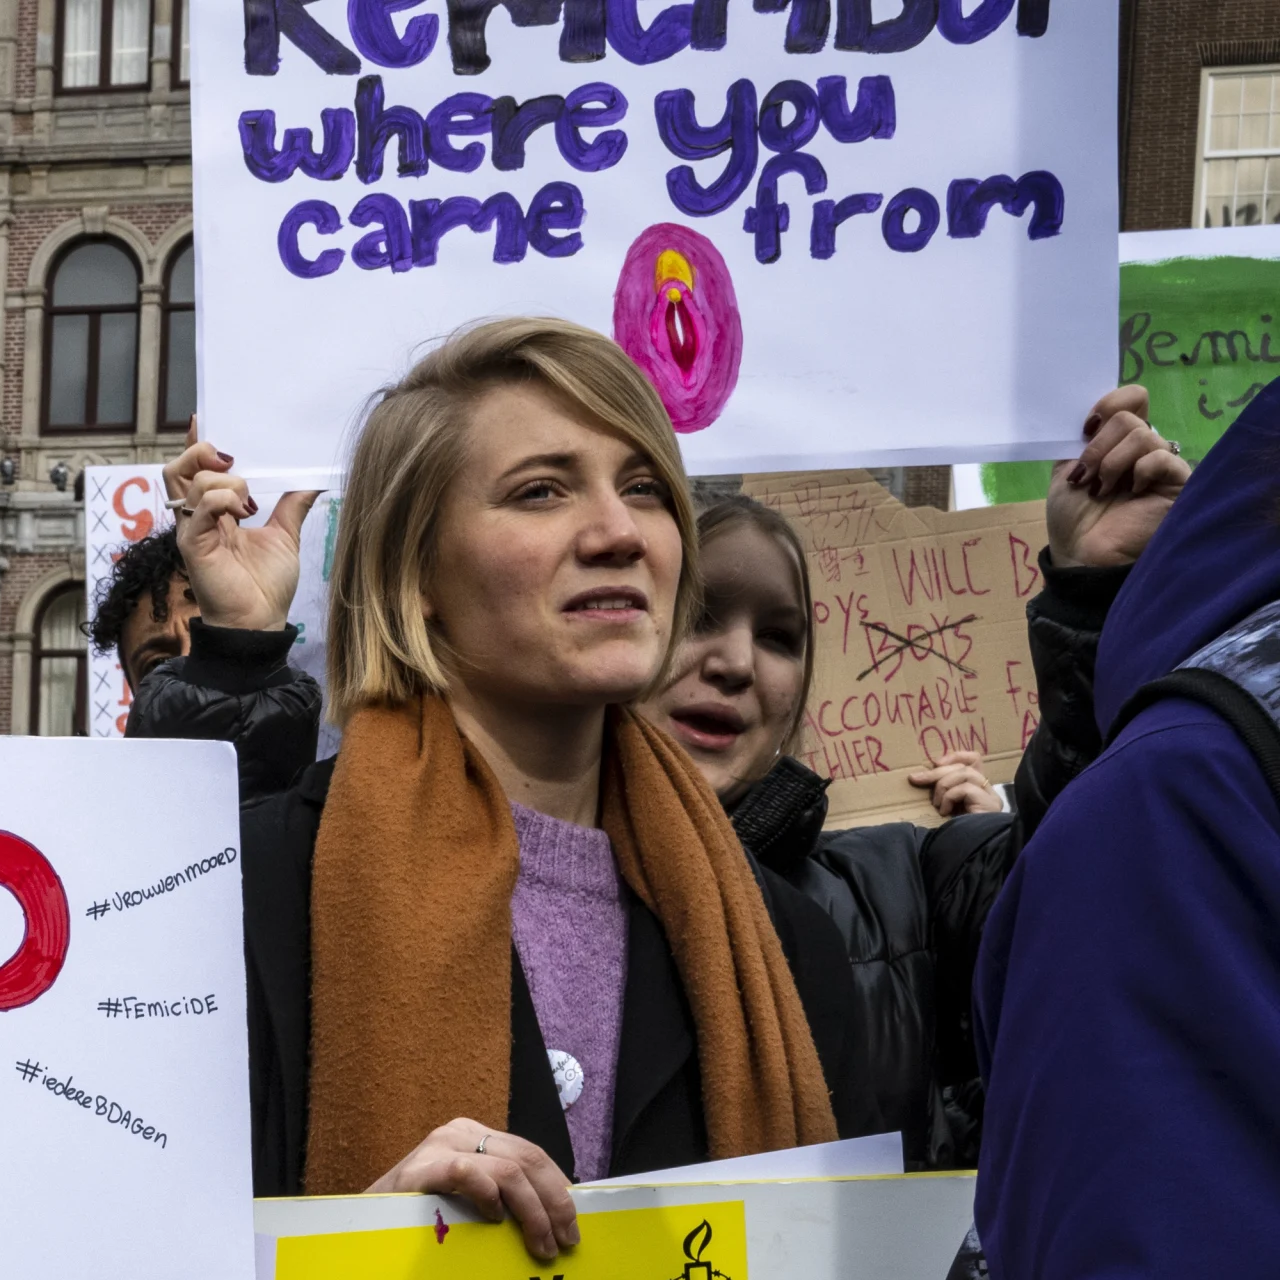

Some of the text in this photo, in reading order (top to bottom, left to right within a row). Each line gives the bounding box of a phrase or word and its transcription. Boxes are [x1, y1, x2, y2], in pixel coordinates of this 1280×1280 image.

[238, 74, 896, 218] where you
[277, 151, 1066, 279] came from
[813, 591, 869, 655] OYS
